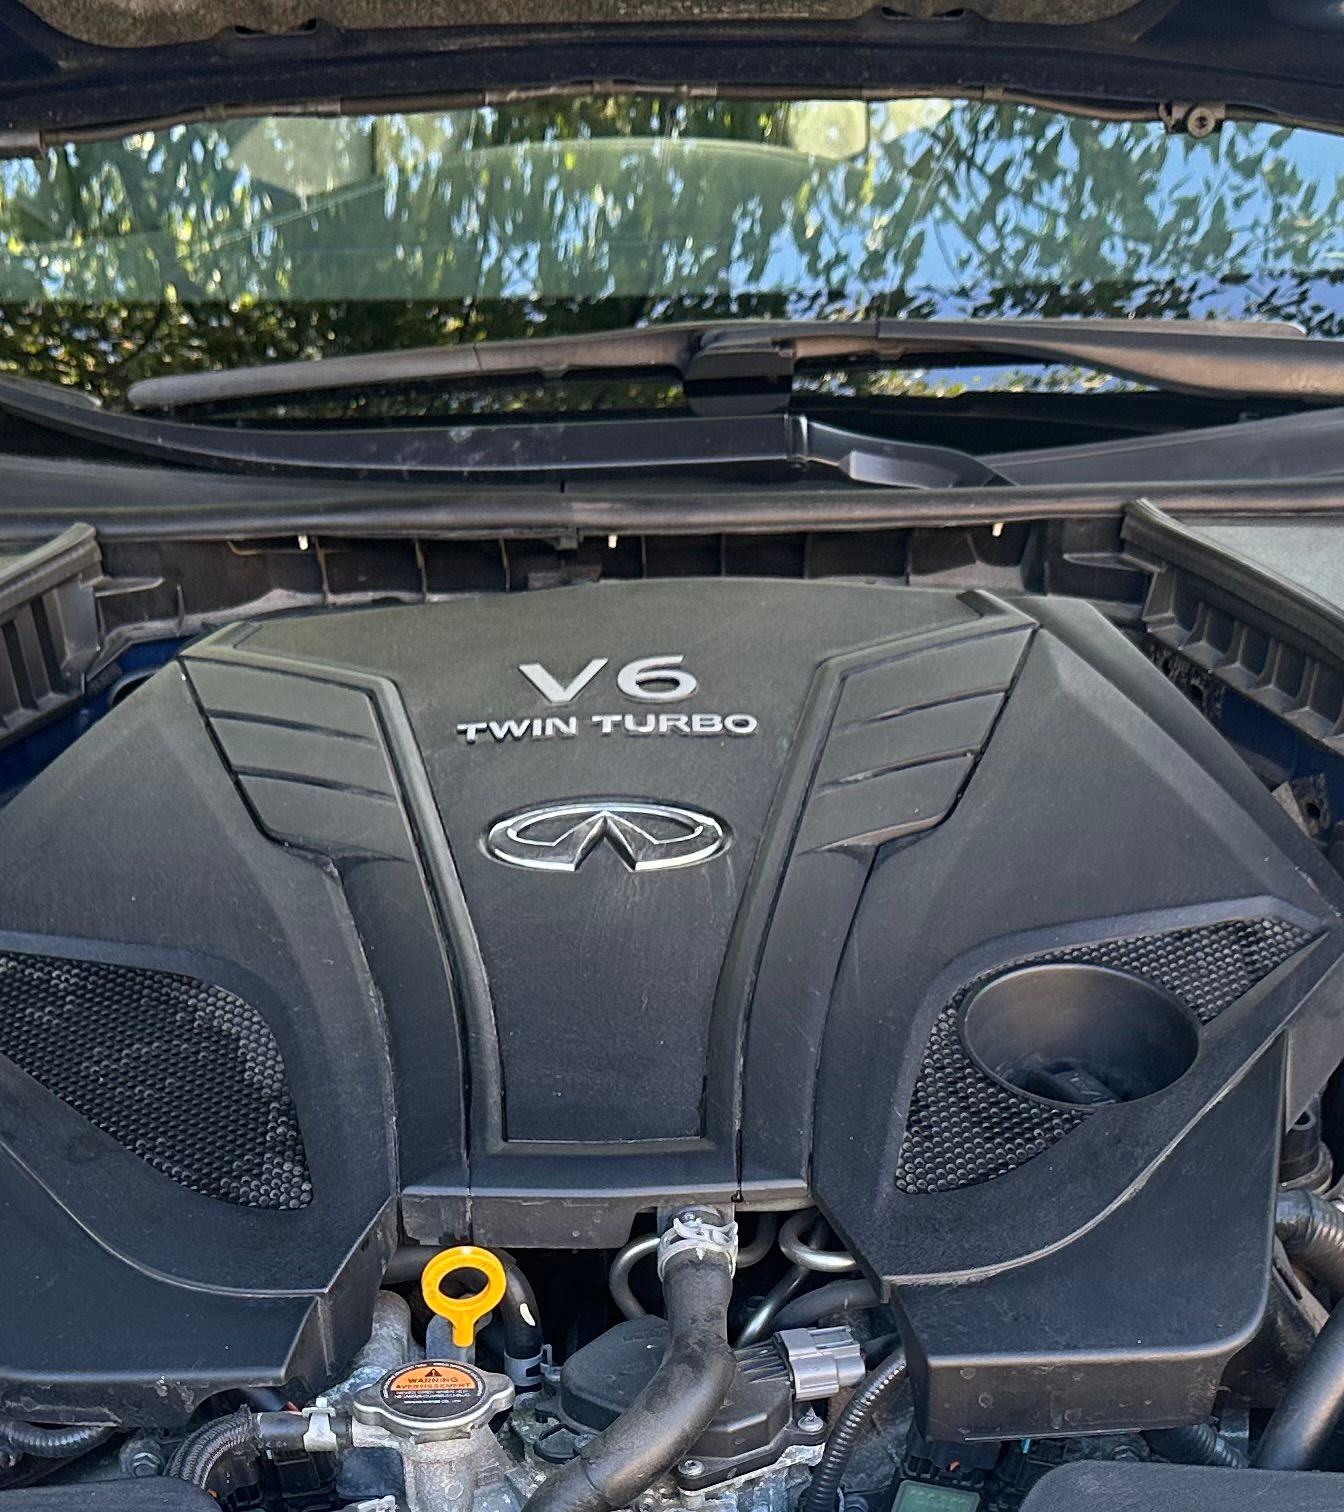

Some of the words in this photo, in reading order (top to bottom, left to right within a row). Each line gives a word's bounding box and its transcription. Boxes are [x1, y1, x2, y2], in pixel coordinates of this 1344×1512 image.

[518, 654, 699, 704] V6
[457, 716, 578, 744] TWIN
[592, 713, 758, 735] TURBO
